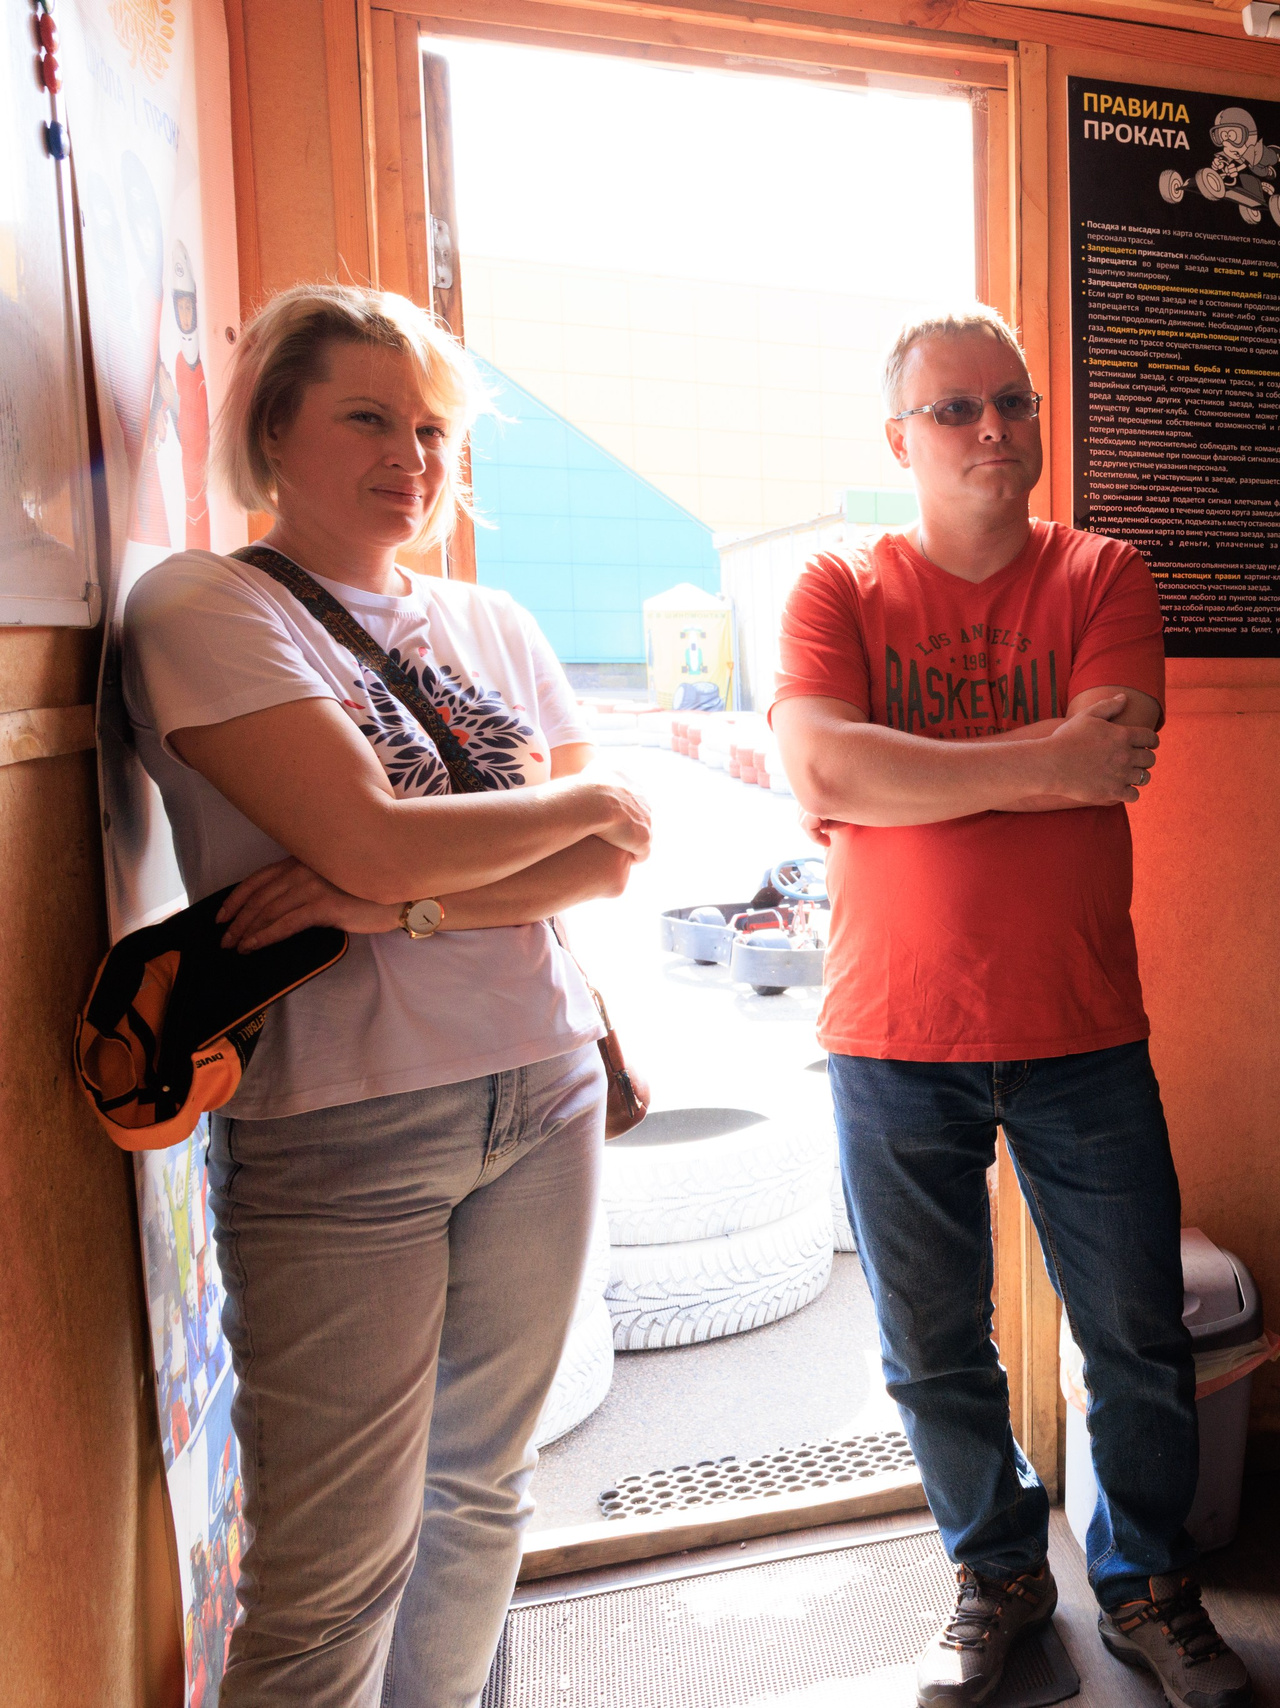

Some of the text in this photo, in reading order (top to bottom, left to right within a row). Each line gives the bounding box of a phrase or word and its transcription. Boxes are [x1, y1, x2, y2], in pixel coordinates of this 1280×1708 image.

[1083, 93, 1190, 124] ПРАВИЛА
[1083, 120, 1190, 150] ПРОКАТА
[1087, 219, 1119, 232] Посадка
[1128, 225, 1160, 236] высадка
[1162, 228, 1171, 236] из
[1173, 229, 1193, 239] карта
[1195, 231, 1250, 245] осуществляется
[1253, 237, 1276, 245] только
[1087, 242, 1137, 257] Запрещается
[1138, 248, 1183, 261] прикасаться
[1190, 252, 1216, 262] любым
[1217, 255, 1241, 264] частям
[1242, 258, 1279, 269] двигателя,
[1087, 254, 1137, 268] Запрещается
[1157, 261, 1179, 272] время
[1185, 264, 1208, 273] заезда
[1214, 266, 1245, 276] вставать
[1250, 269, 1258, 277] из
[1087, 276, 1137, 291] Запрещается
[1138, 282, 1199, 296] одновременное
[1199, 287, 1230, 296] нажатие
[1231, 288, 1262, 300] педалей
[1087, 301, 1139, 313] запрещается
[1145, 305, 1207, 319] предпринимать
[1212, 309, 1256, 321] какие-либо
[1088, 345, 1182, 361] (против часовой стрелки).
[1089, 356, 1138, 369] Запрещается
[1148, 362, 1190, 371] контактная
[1194, 363, 1220, 375] борьба
[1089, 403, 1130, 414] имуществу
[1135, 404, 1189, 417] картинг-клуба.
[1194, 407, 1250, 418] Столкновением
[1255, 412, 1278, 420] может
[1088, 413, 1115, 424] случай
[1118, 416, 1162, 427] переоценки
[1165, 417, 1211, 427] собственных
[1215, 420, 1266, 430] возможностей
[1089, 435, 1136, 446] Необходимо
[1139, 439, 1197, 450] неукоснительно
[1199, 441, 1238, 451] соблюдать
[1089, 469, 1139, 480] Посетителям,
[1153, 473, 1202, 483] участвующим
[1211, 476, 1238, 484] заезде,
[1245, 563, 1267, 571] заезду
[1158, 581, 1272, 592] безопасность участников заезда.
[916, 624, 1032, 656] LOS ANELES
[963, 653, 988, 671] 198
